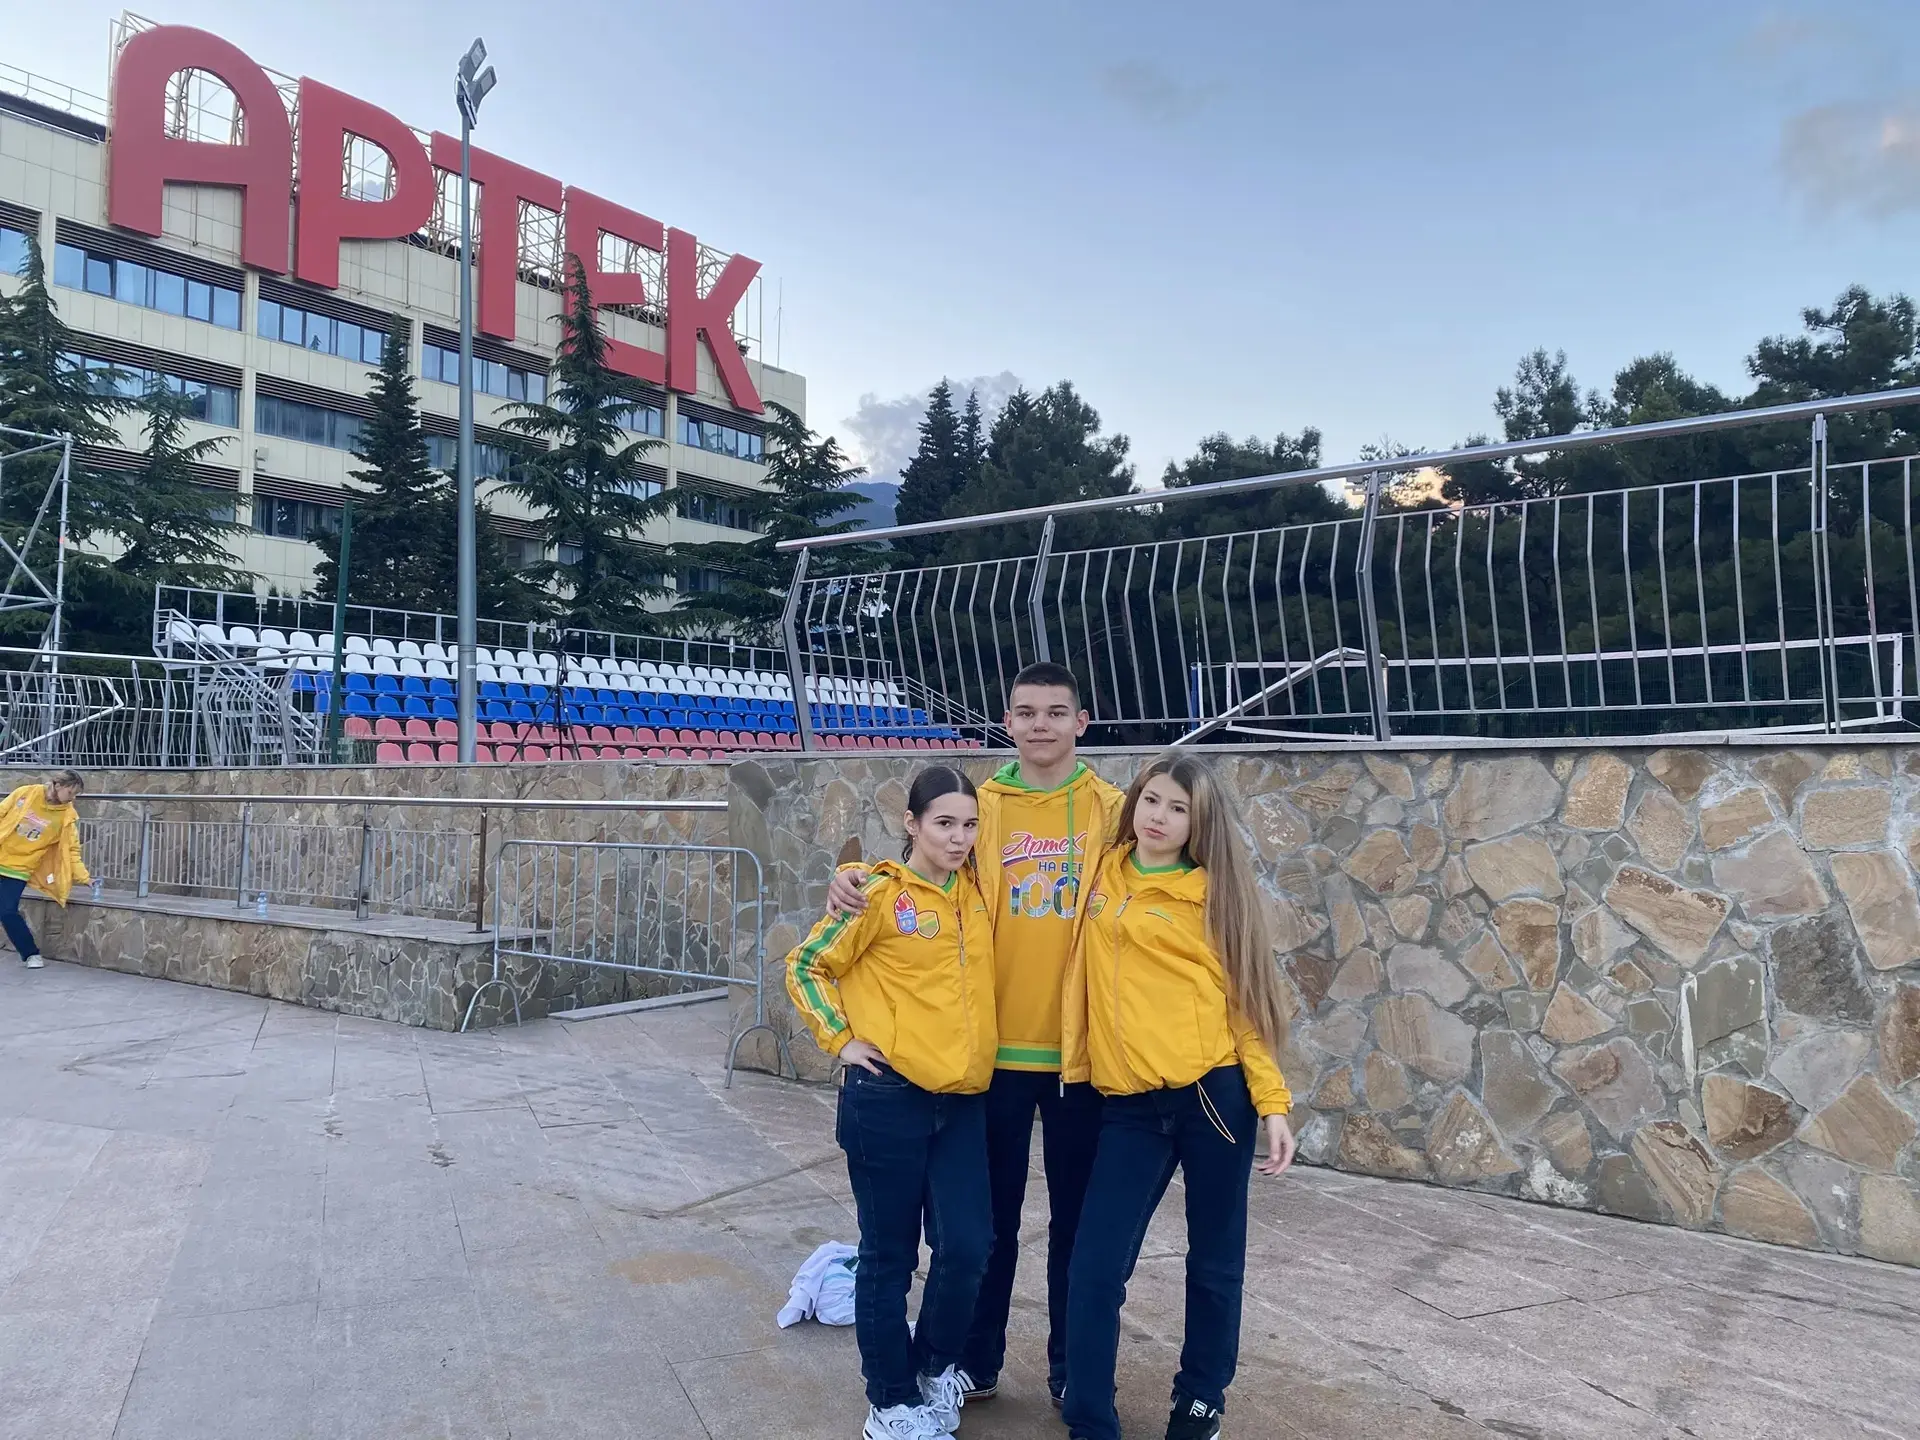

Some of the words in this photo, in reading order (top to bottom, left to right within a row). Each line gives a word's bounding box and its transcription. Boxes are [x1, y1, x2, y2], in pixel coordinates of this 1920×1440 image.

[110, 24, 765, 415] АРТЕК
[1038, 861, 1056, 872] НА
[1007, 872, 1080, 919] 100
